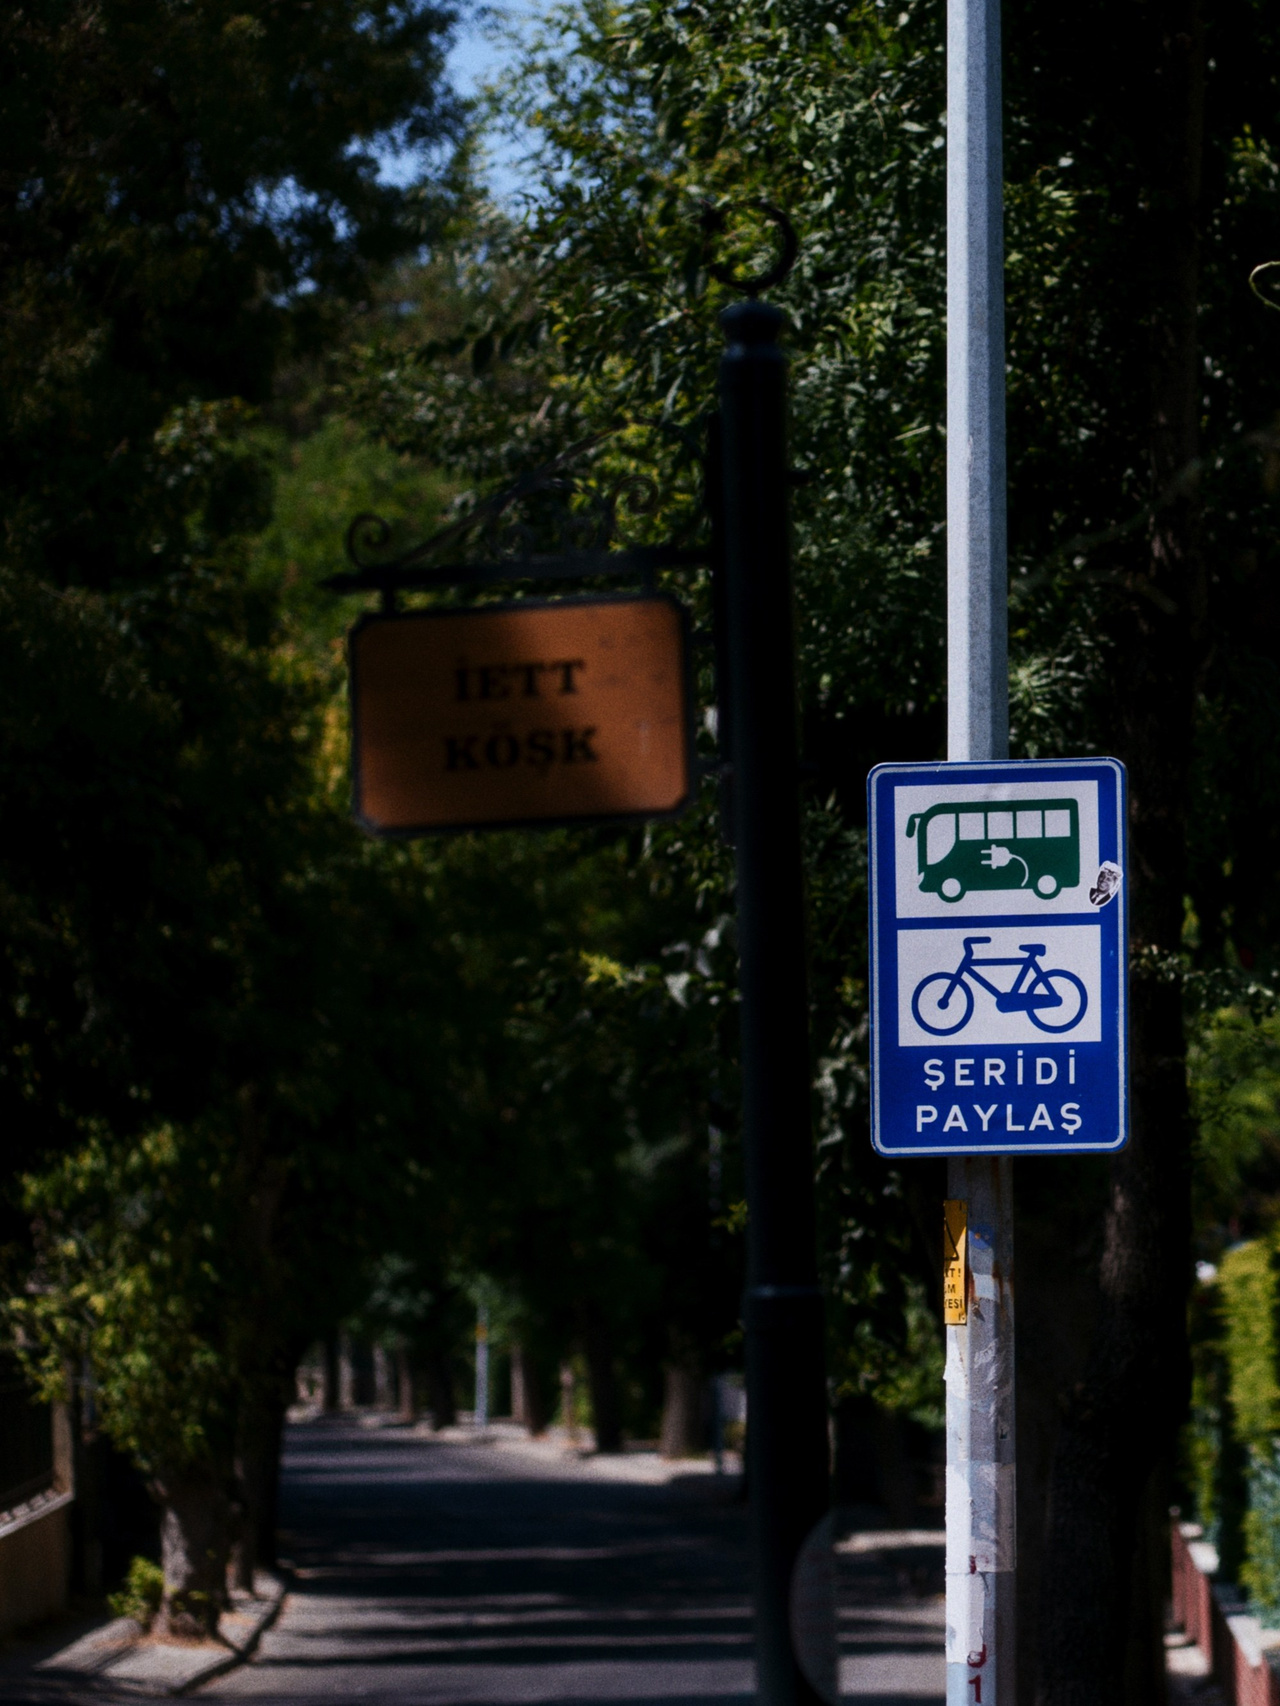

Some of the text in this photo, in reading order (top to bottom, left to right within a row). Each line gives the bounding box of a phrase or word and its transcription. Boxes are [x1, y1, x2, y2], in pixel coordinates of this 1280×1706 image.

[454, 657, 585, 701] İETT
[445, 719, 598, 775] KÖŞK
[923, 1048, 1076, 1092] ŞERİDİ
[916, 1102, 1083, 1135] PAYLAŞ
